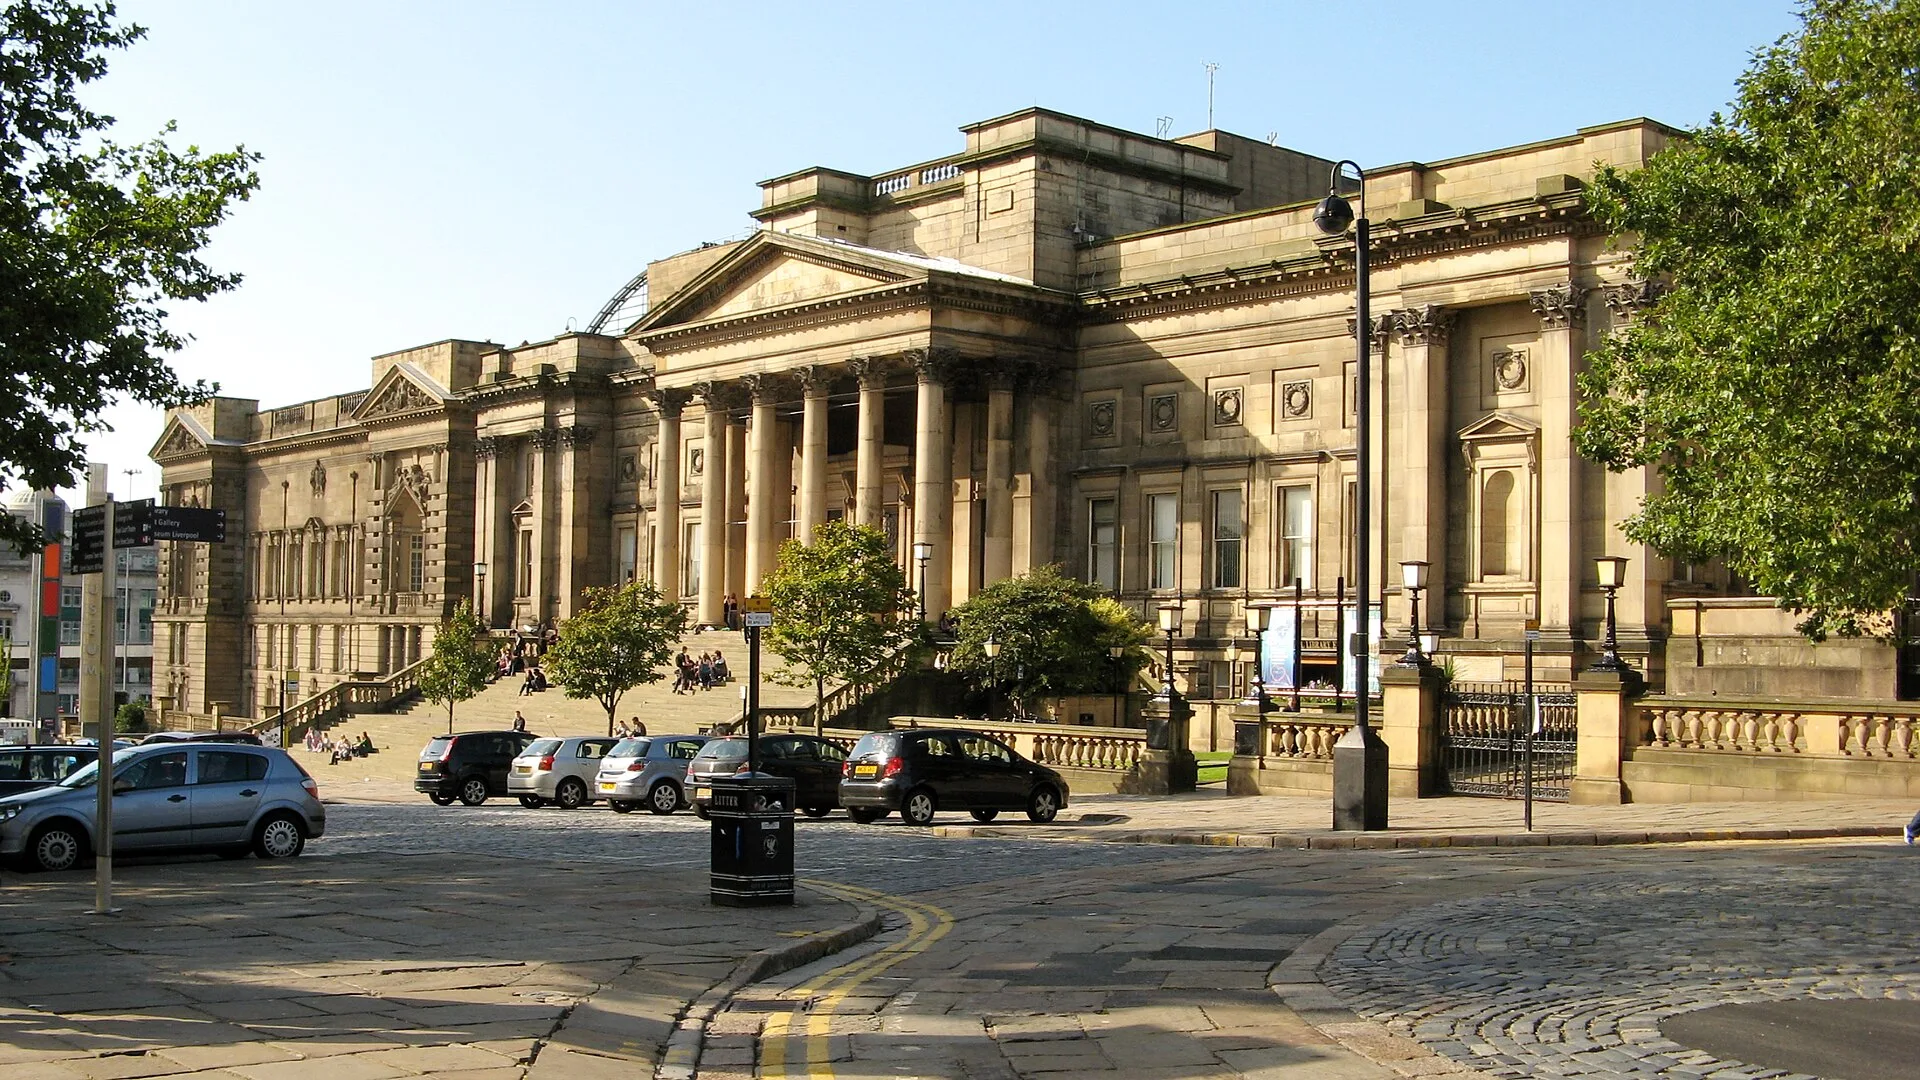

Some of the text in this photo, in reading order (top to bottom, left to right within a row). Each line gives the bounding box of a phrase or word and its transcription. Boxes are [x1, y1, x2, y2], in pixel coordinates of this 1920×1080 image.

[158, 519, 180, 527] Gallery
[172, 531, 199, 539] Liverpool
[714, 795, 738, 807] LITTER
